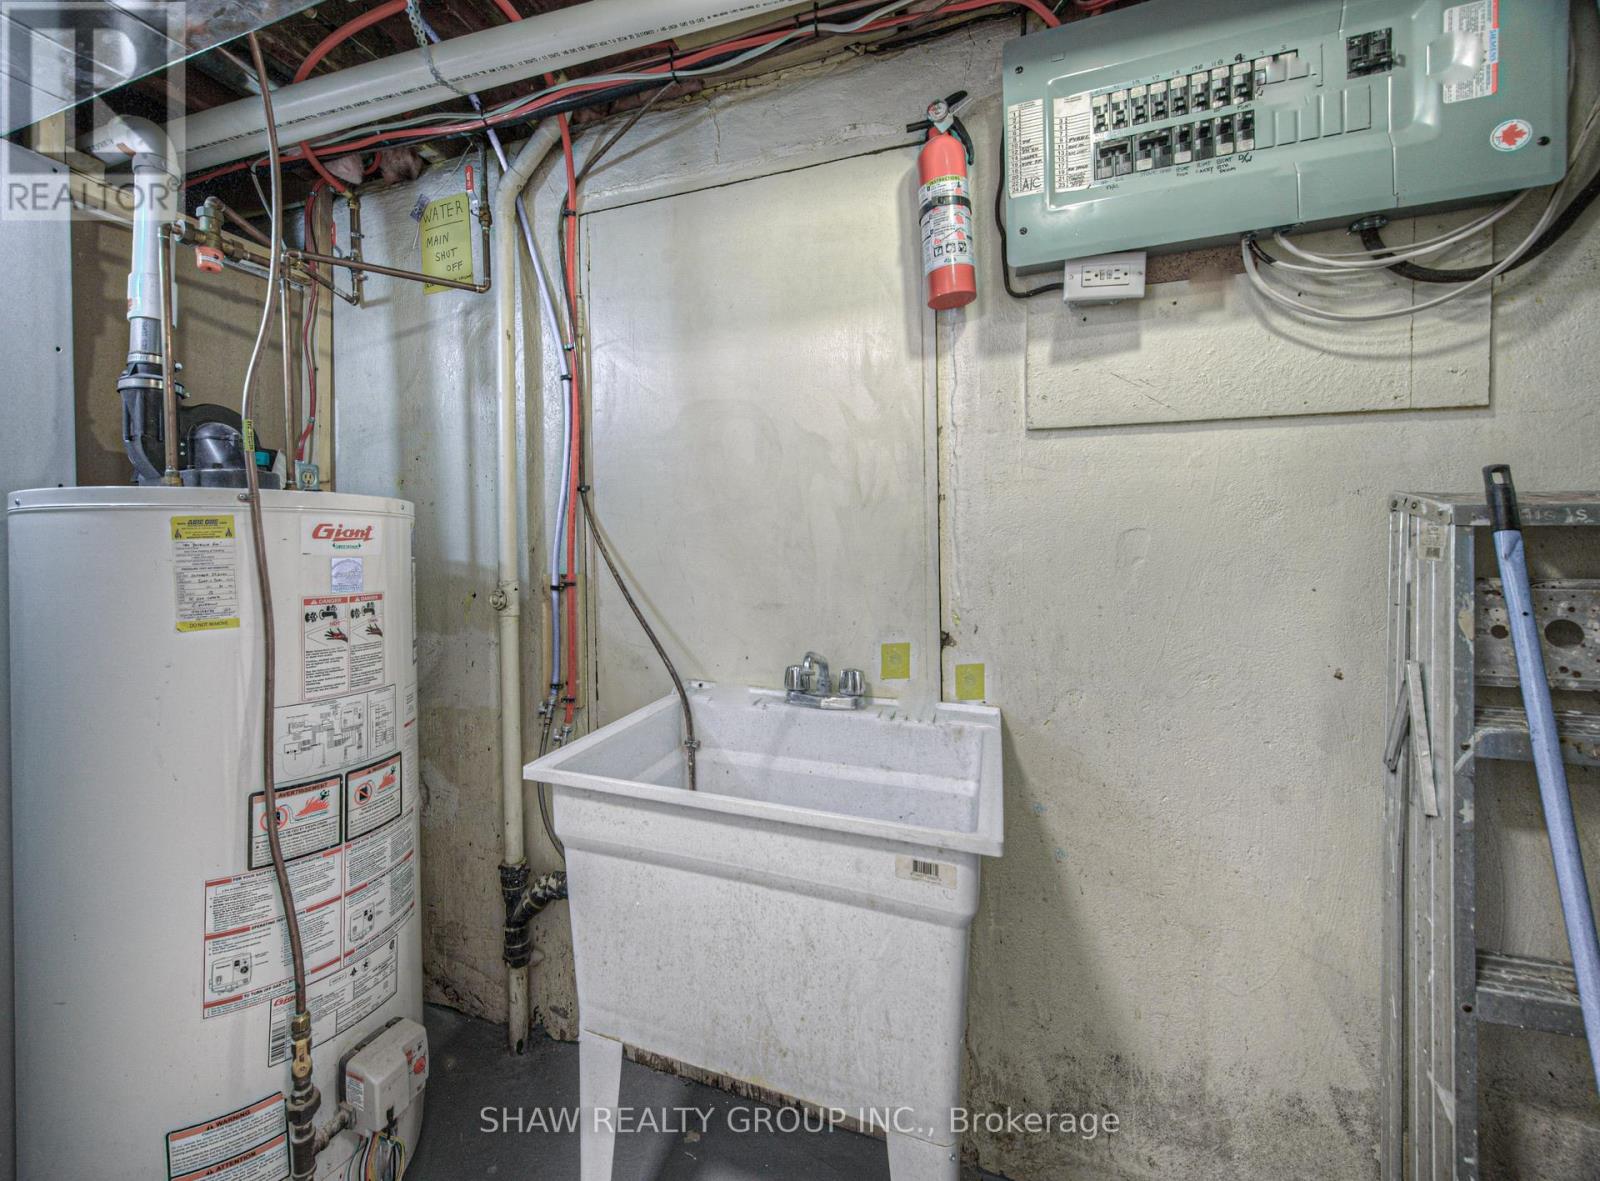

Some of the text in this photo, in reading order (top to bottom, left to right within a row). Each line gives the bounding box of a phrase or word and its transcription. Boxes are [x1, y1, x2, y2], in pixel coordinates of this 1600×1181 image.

[1023, 176, 1042, 191] A/C
[424, 200, 463, 223] WATER
[426, 232, 450, 248] MAIN
[435, 247, 458, 262] SHUT
[446, 260, 463, 272] OFF
[312, 523, 375, 542] Giant
[278, 782, 328, 798] AVERTISSEMENT
[215, 1110, 251, 1127] WARNING
[216, 1151, 256, 1171] ATTENTION
